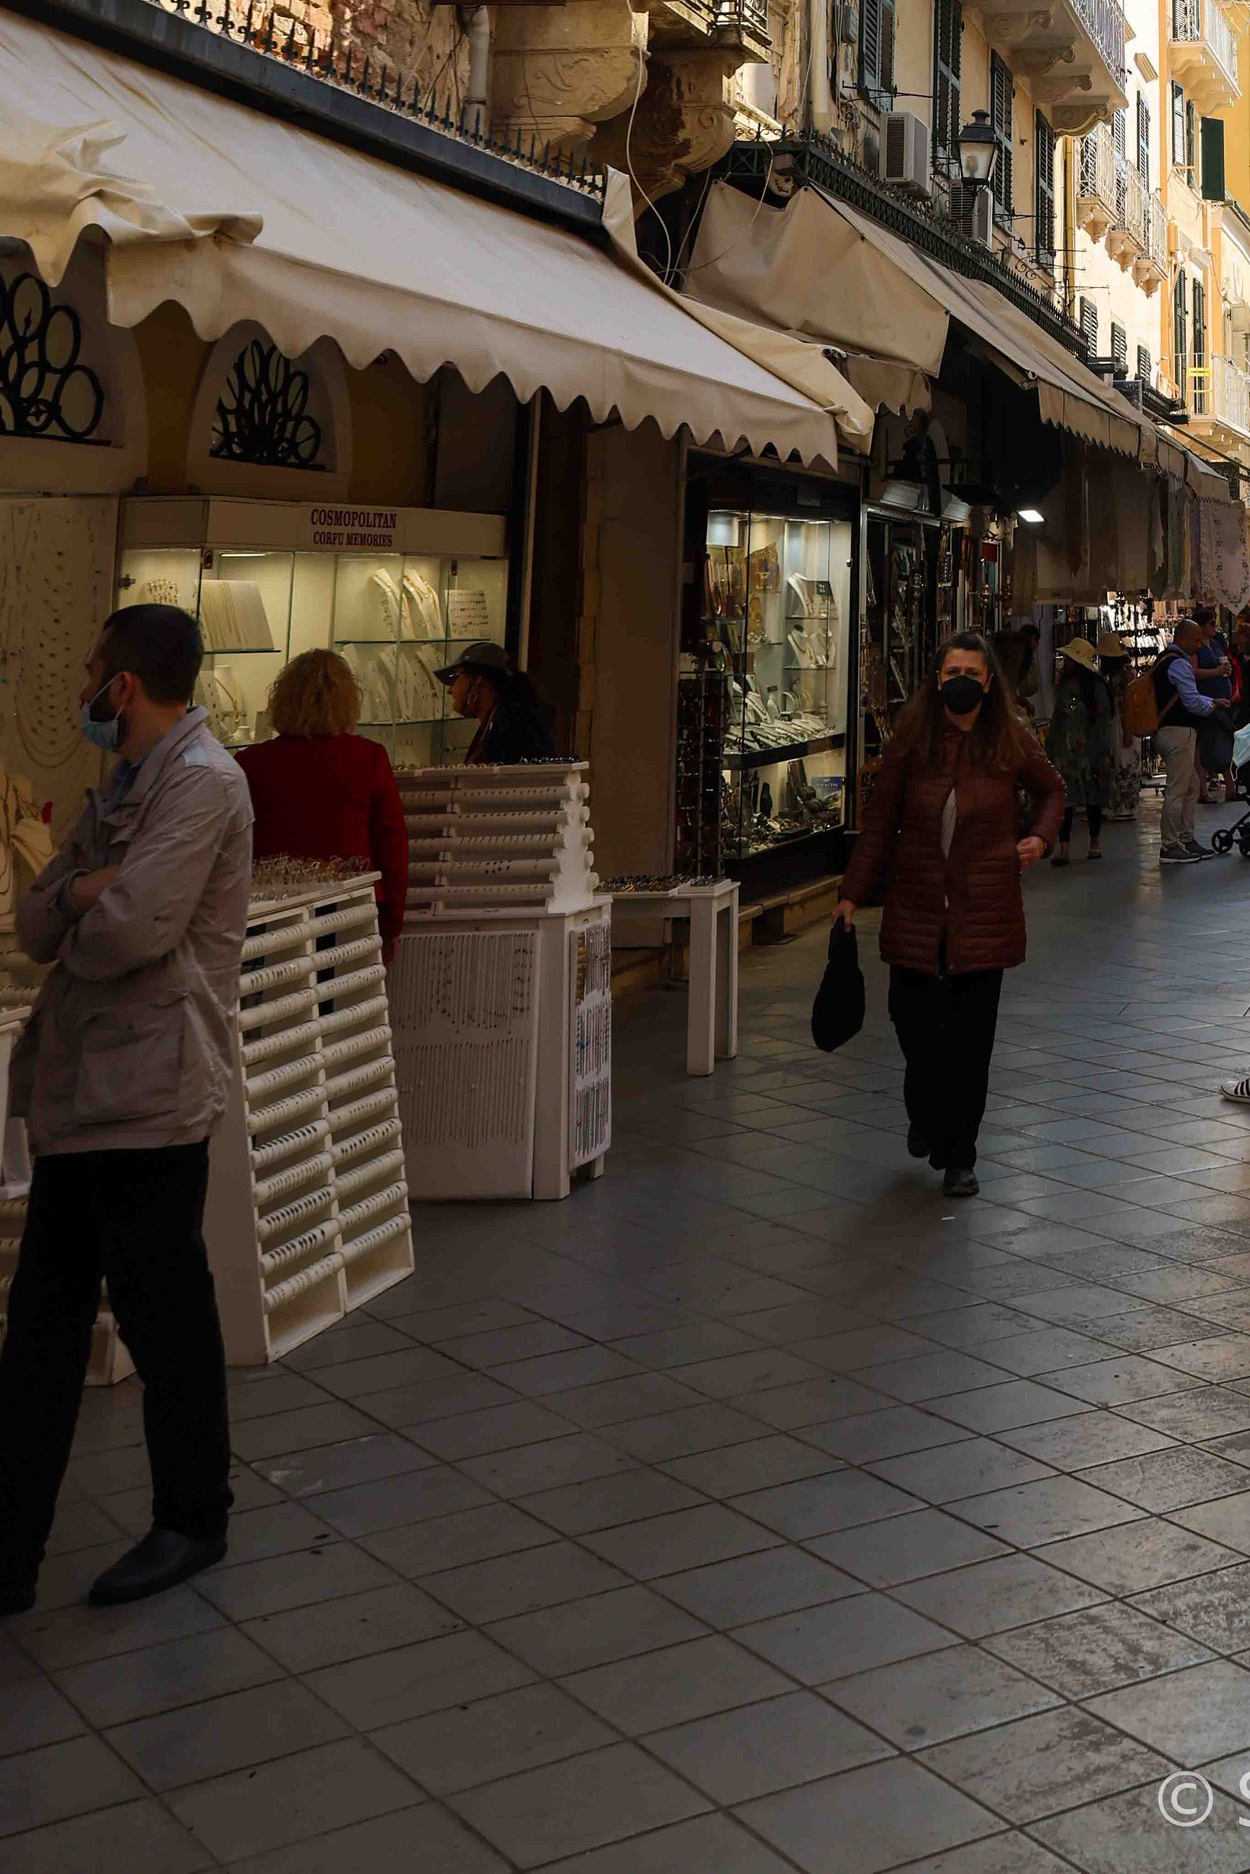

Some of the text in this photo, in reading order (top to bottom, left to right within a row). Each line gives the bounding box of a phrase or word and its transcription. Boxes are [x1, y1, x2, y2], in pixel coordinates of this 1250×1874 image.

[311, 508, 397, 528] COSMOPOLITAN
[313, 531, 392, 547] CORFU MEMORIES
